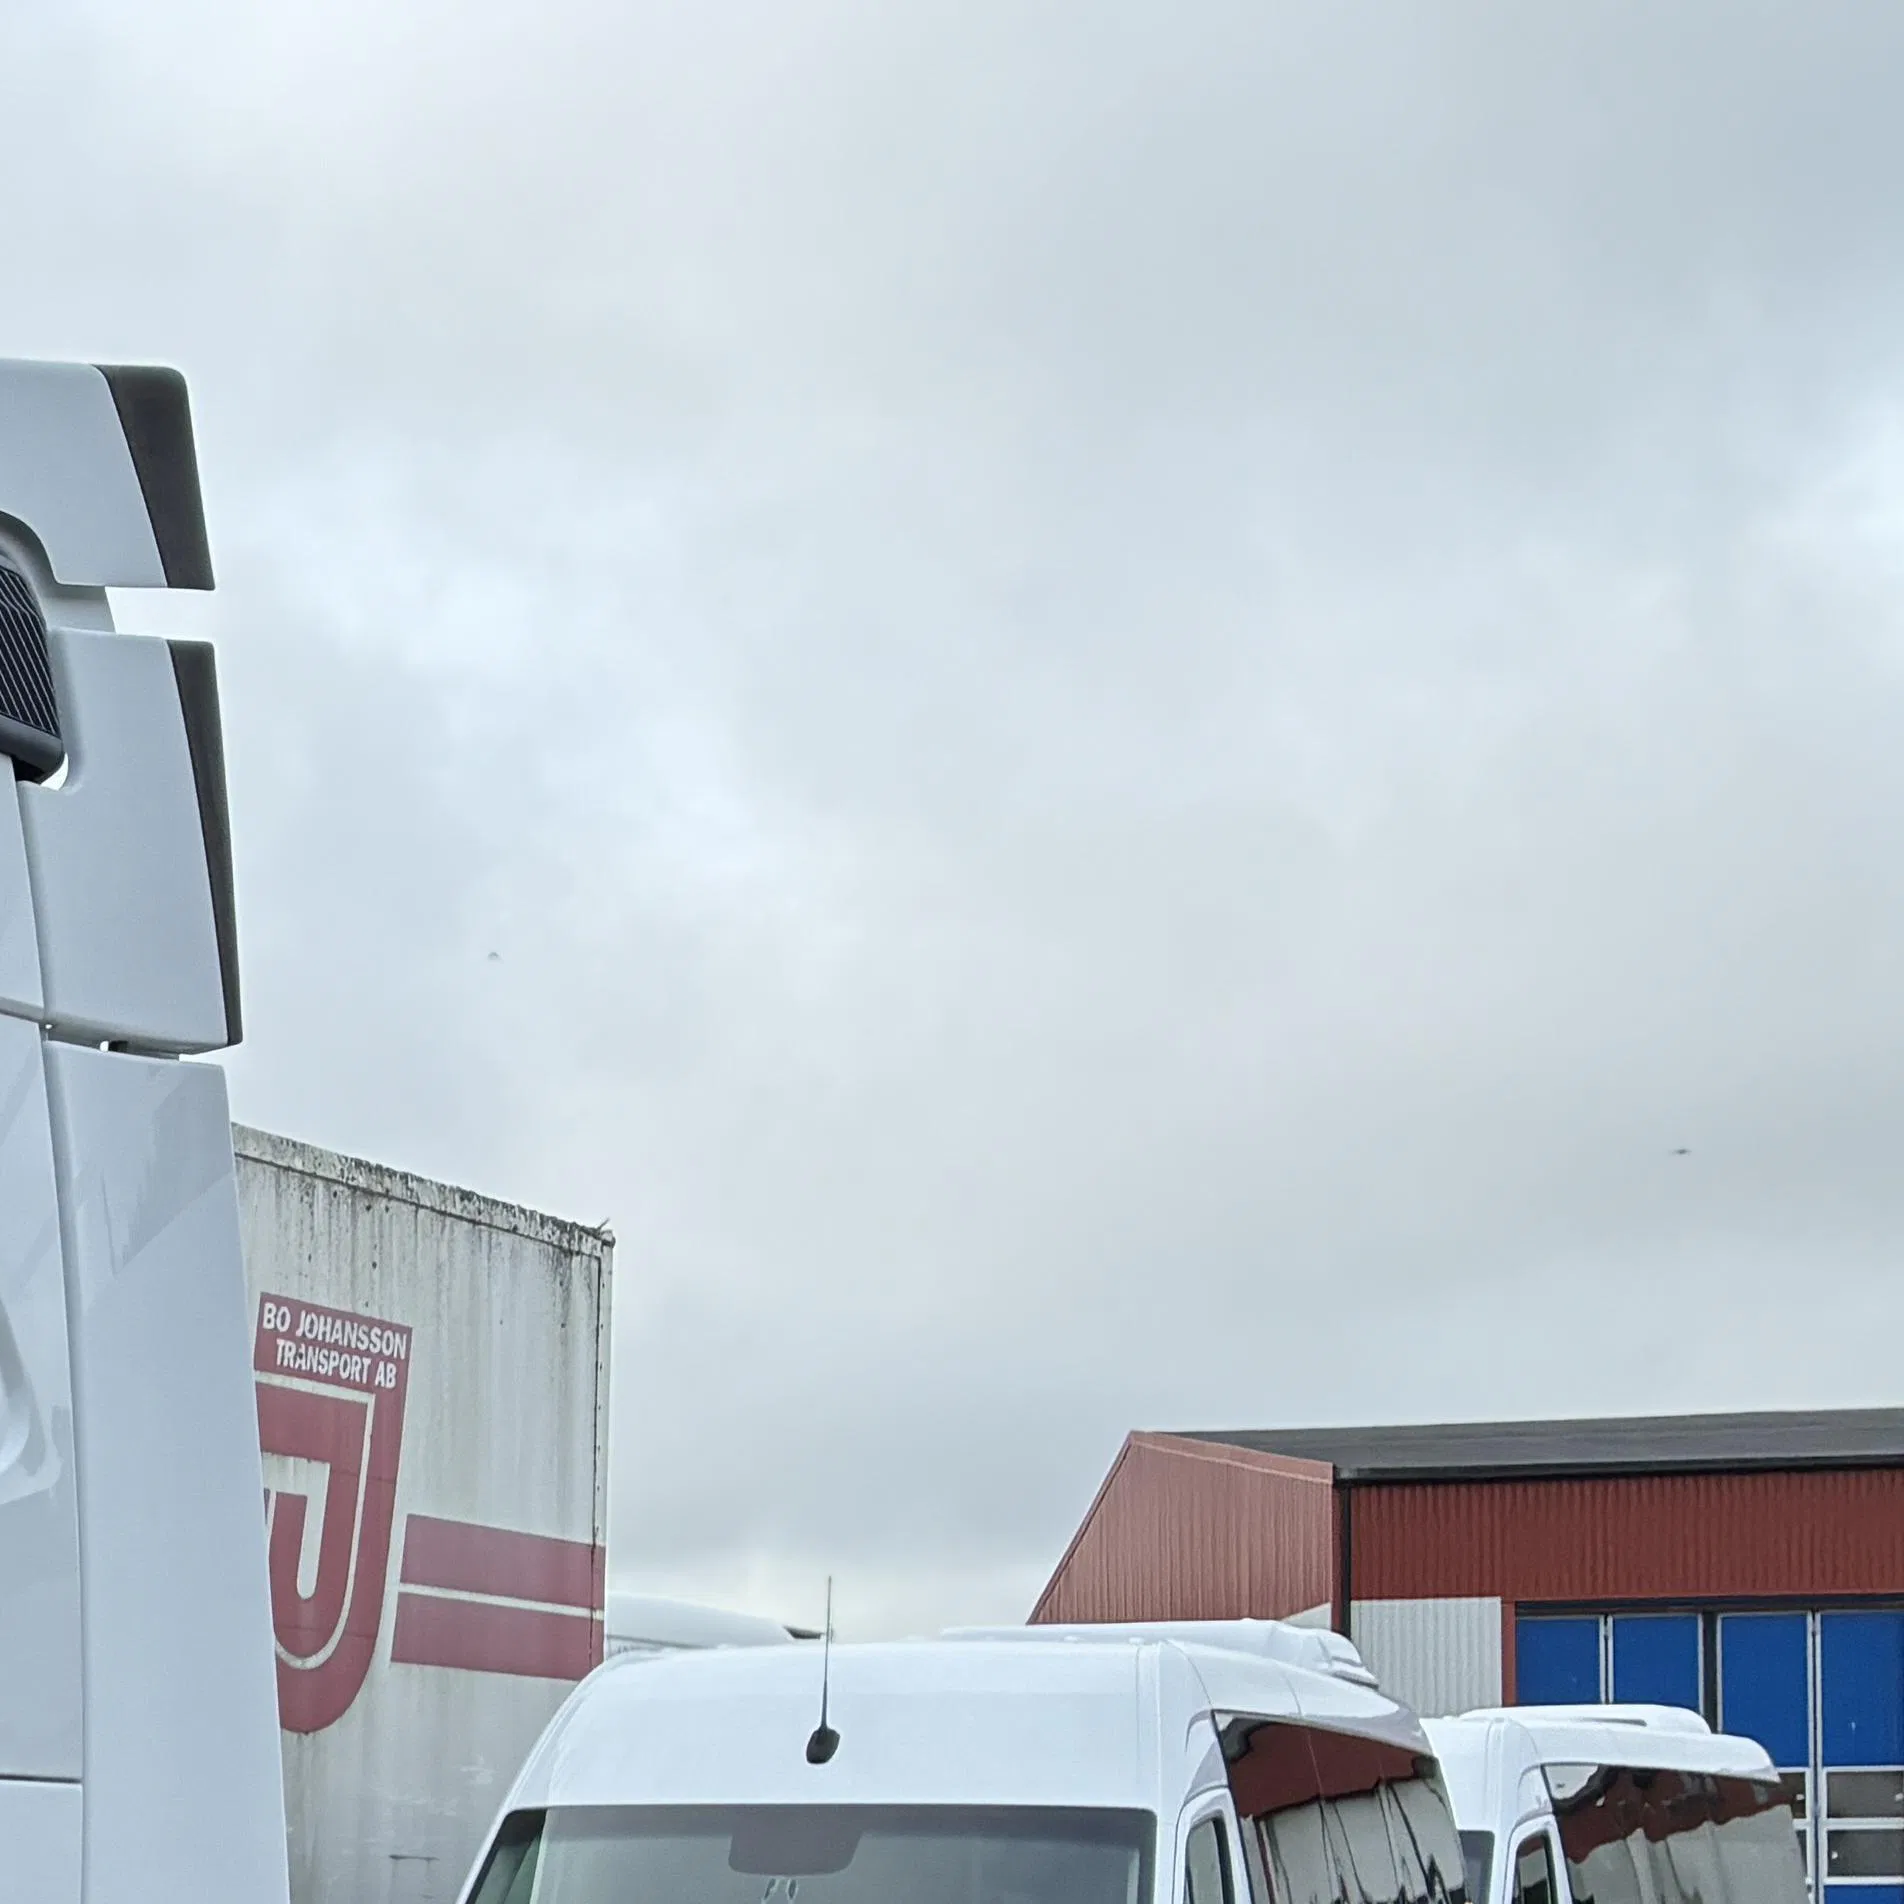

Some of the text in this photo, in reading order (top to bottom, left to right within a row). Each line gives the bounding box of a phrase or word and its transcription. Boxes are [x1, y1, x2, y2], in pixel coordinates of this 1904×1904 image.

[262, 1302, 407, 1360] BO JOHANSSON
[276, 1338, 397, 1389] TRANSPORT AB
